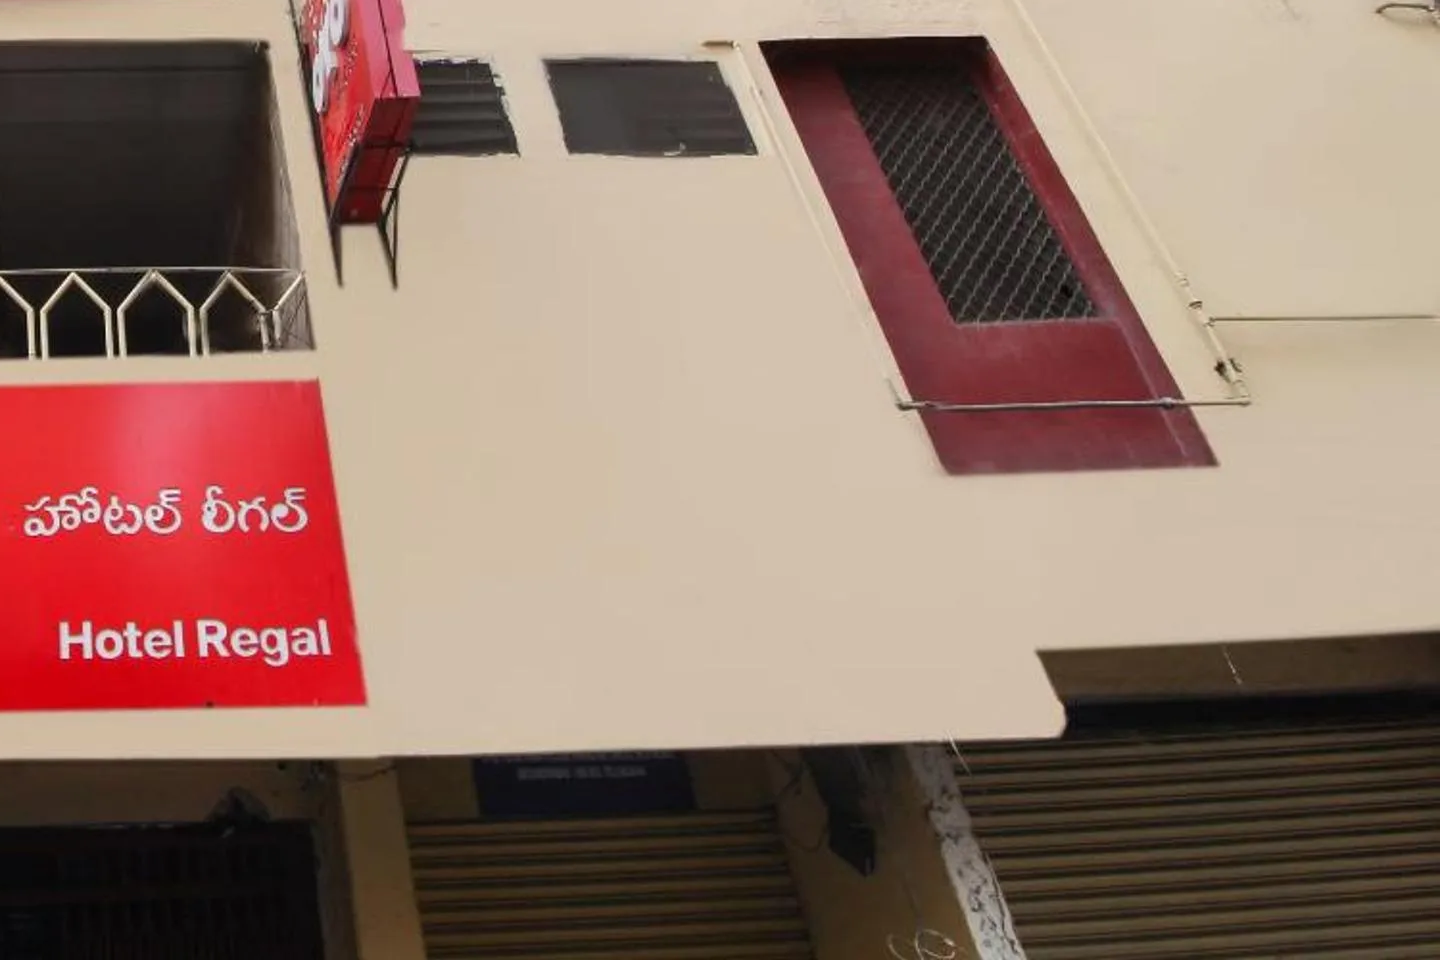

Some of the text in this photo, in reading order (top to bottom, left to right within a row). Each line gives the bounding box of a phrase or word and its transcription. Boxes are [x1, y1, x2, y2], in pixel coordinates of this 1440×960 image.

[24, 486, 182, 536] హోటల్
[59, 618, 332, 666] Hotel Regal
